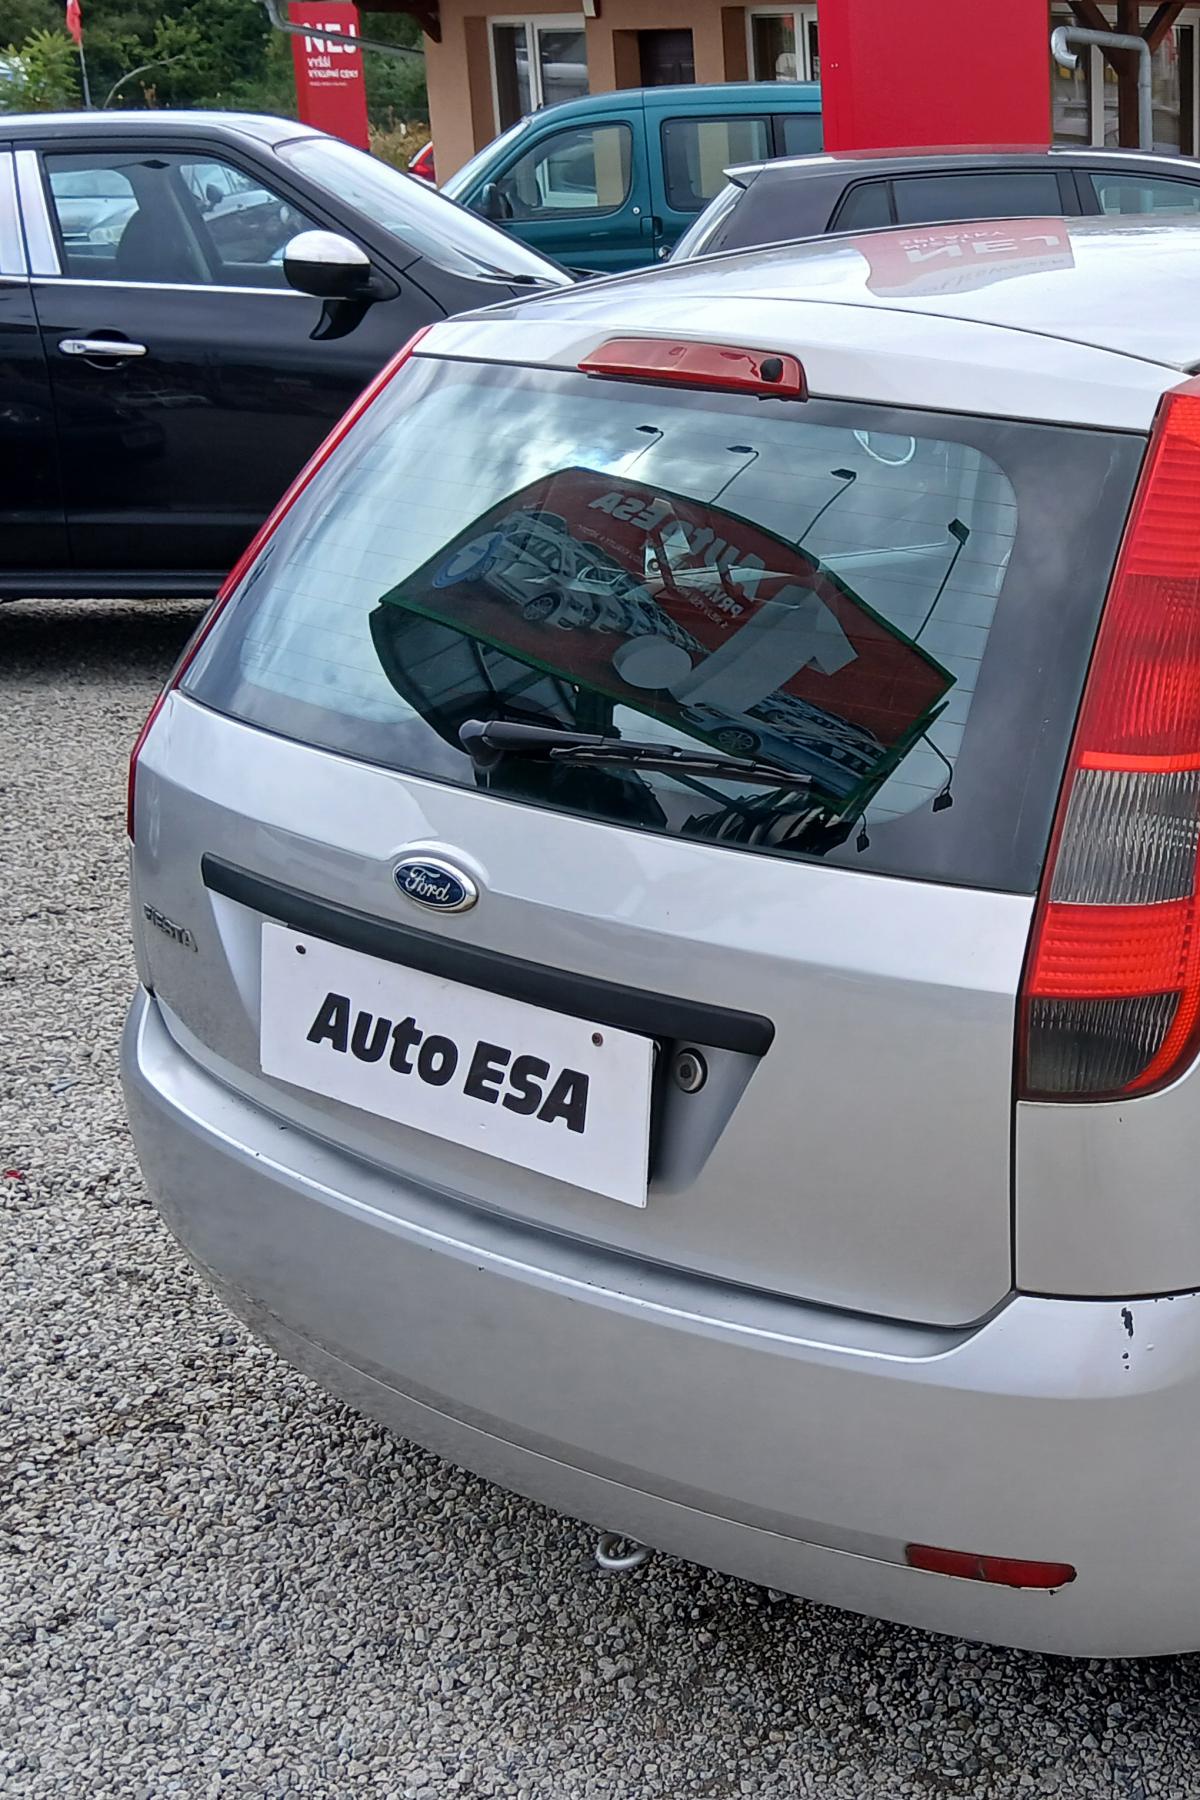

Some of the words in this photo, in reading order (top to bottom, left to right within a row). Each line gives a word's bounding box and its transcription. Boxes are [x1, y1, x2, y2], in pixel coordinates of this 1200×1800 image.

[303, 23, 357, 53] NEJ
[405, 866, 451, 901] Ford
[306, 992, 458, 1086] Auto
[463, 1040, 590, 1134] ESA
